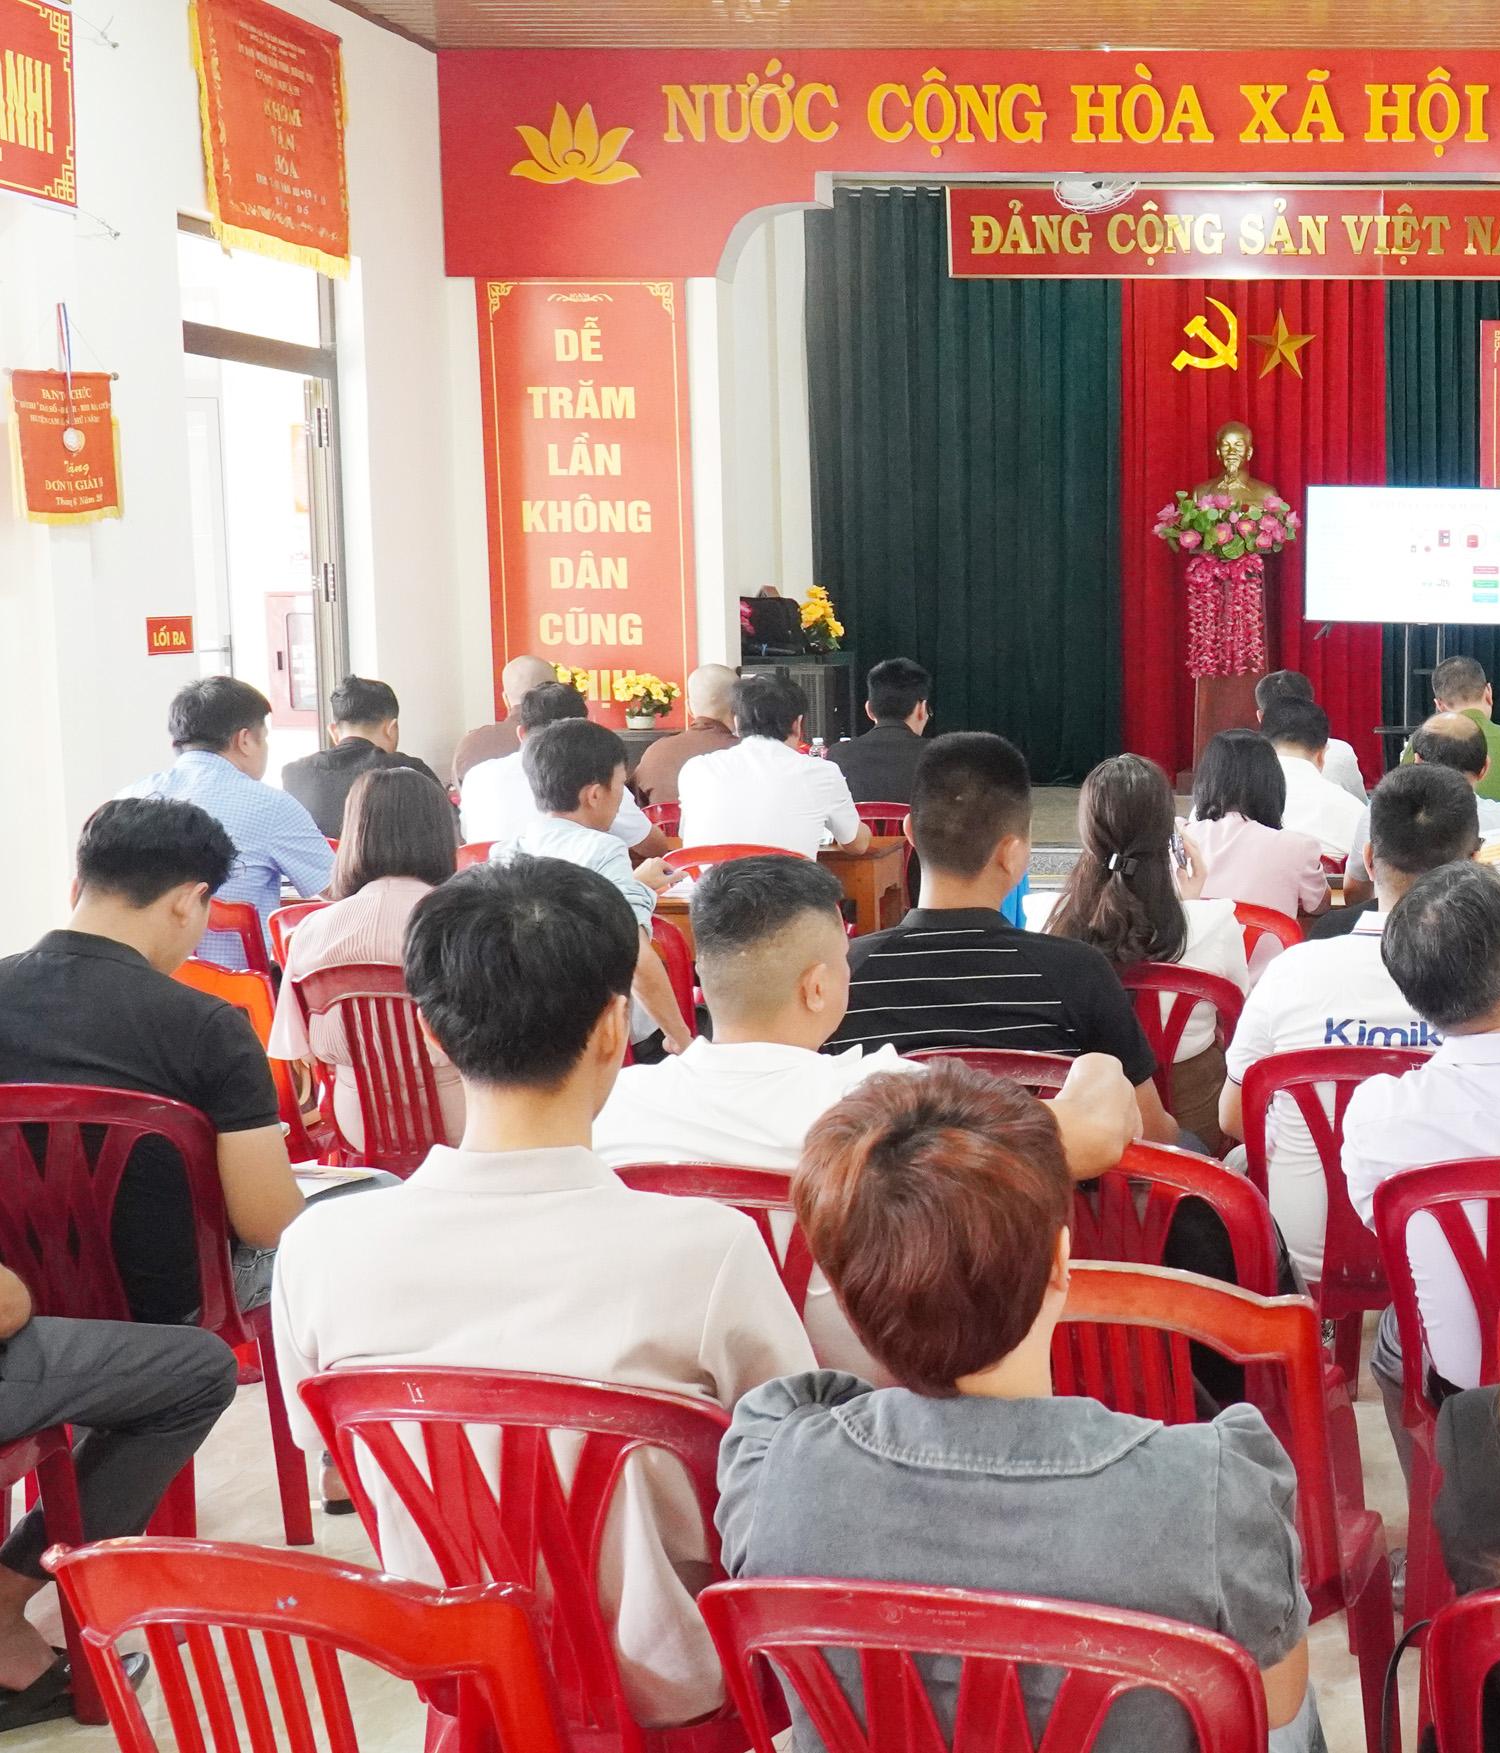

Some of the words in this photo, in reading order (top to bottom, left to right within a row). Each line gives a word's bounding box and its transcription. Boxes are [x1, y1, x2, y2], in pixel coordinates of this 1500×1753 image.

[663, 58, 838, 143] NƯỚC
[867, 66, 1047, 158] CỘNG
[1070, 63, 1213, 144] HÒA
[1239, 69, 1344, 143] XÃ
[1364, 66, 1488, 158] HỘI
[970, 199, 1092, 254] ĐẢNG
[1106, 201, 1225, 265] CỘNG
[1239, 199, 1327, 255] SẢN
[1341, 203, 1450, 265] VIỆT
[555, 317, 603, 362] DỄ
[528, 380, 635, 419] TRĂM
[548, 432, 621, 476] LẦN
[522, 494, 651, 533] KHÔNG
[551, 550, 628, 589] DÂN
[153, 625, 171, 647] LỐI
[171, 631, 187, 646] RA
[539, 607, 643, 645] CŨNG
